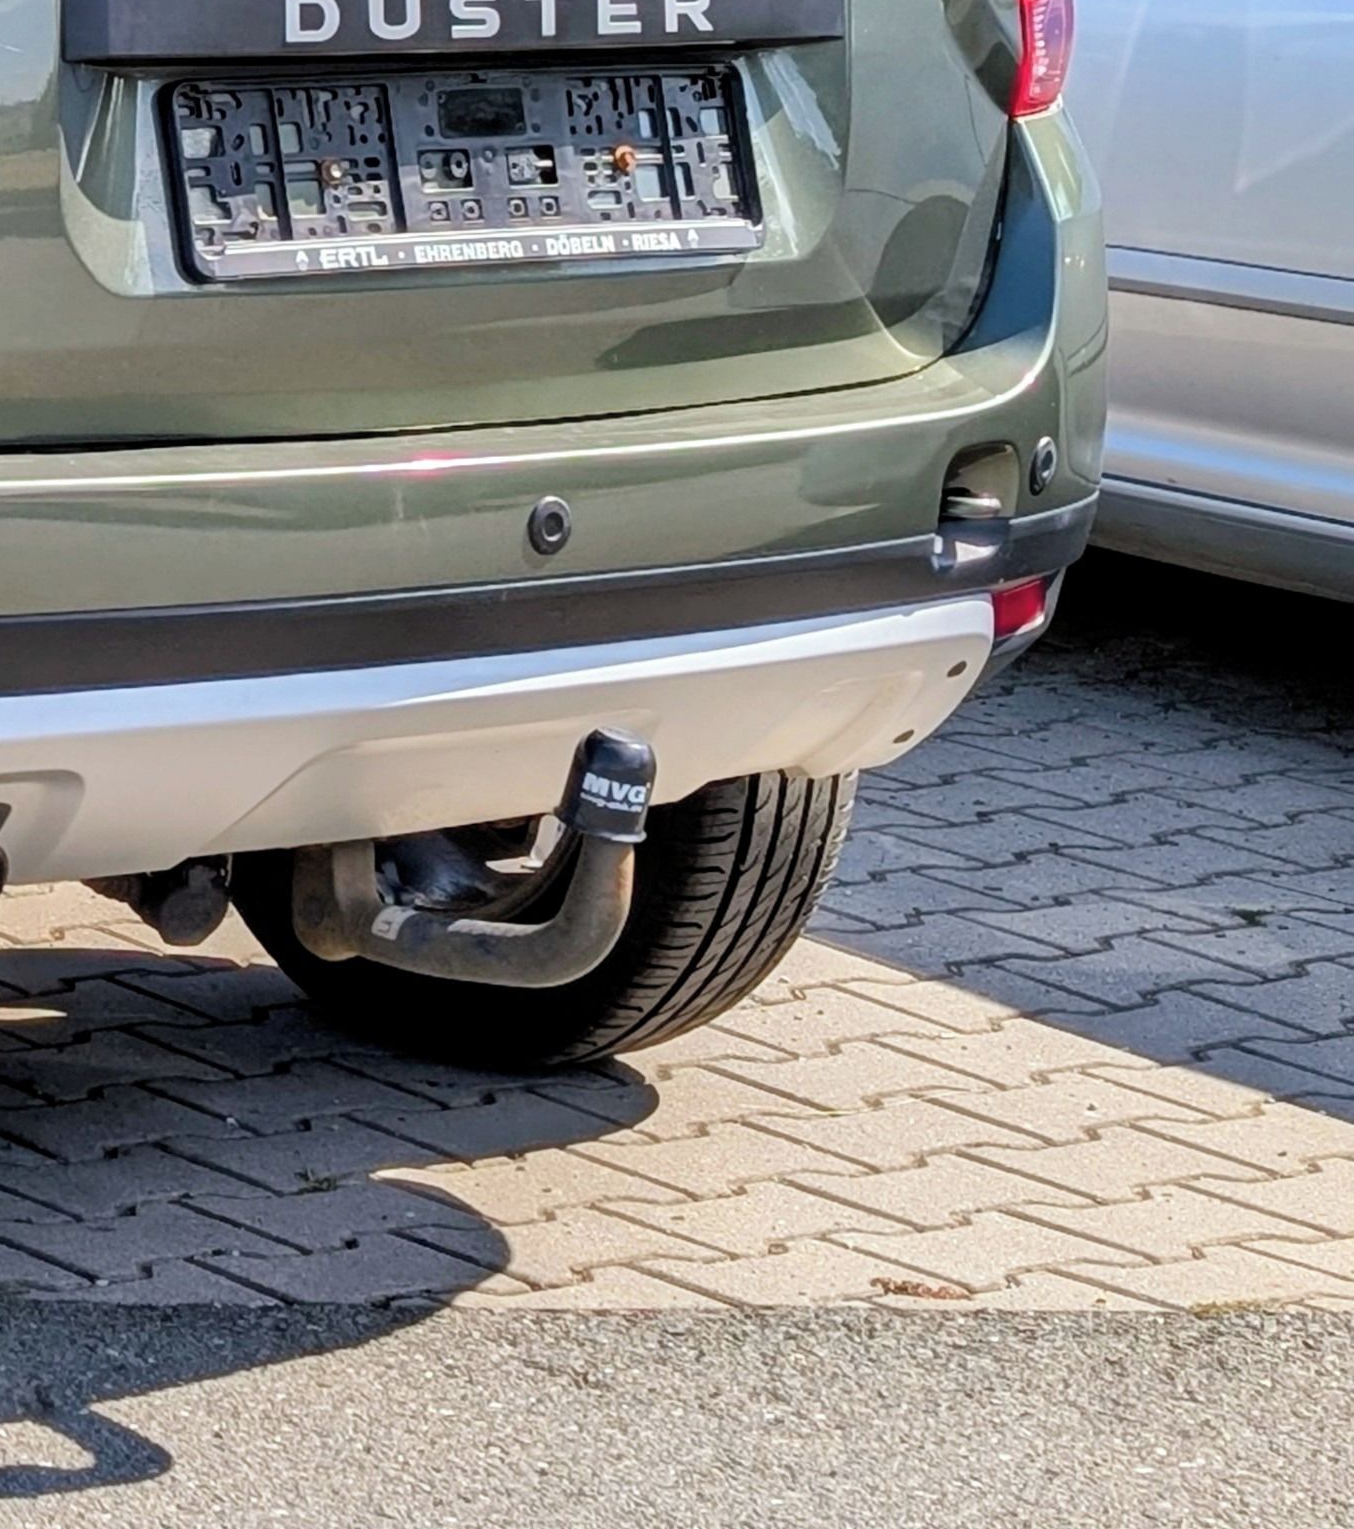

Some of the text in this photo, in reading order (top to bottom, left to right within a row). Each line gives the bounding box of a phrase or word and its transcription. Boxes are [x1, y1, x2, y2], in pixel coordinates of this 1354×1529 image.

[415, 239, 524, 265] EHRENBERG
[546, 233, 616, 257] DÖBELN
[632, 229, 682, 252] RIESA
[582, 771, 647, 804] MVG
